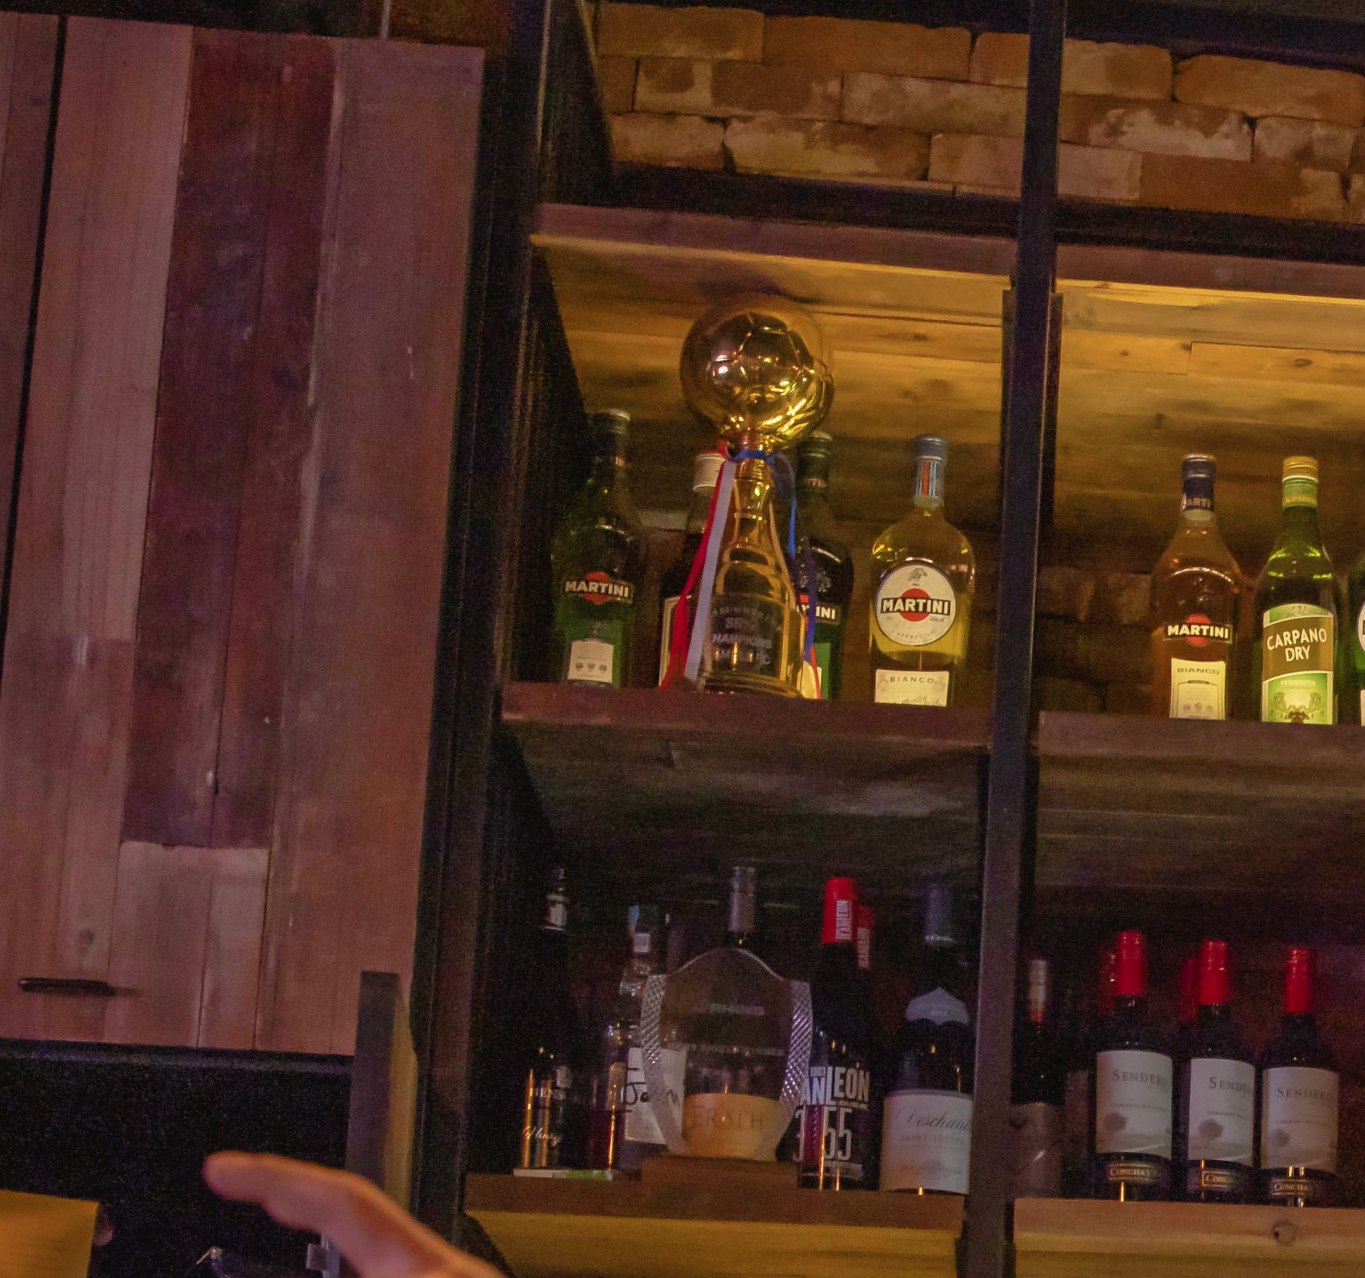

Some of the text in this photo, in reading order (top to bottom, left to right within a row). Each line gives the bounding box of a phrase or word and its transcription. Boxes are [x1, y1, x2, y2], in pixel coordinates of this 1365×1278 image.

[565, 581, 629, 598] MARTINI
[883, 599, 949, 615] MARTINI
[1168, 625, 1229, 639] MARTINI
[1266, 628, 1328, 650] CARPANO
[1285, 646, 1311, 662] DRY
[1177, 667, 1220, 675] BIANCO
[889, 676, 935, 684] BIANCO
[826, 1066, 870, 1105] LEON
